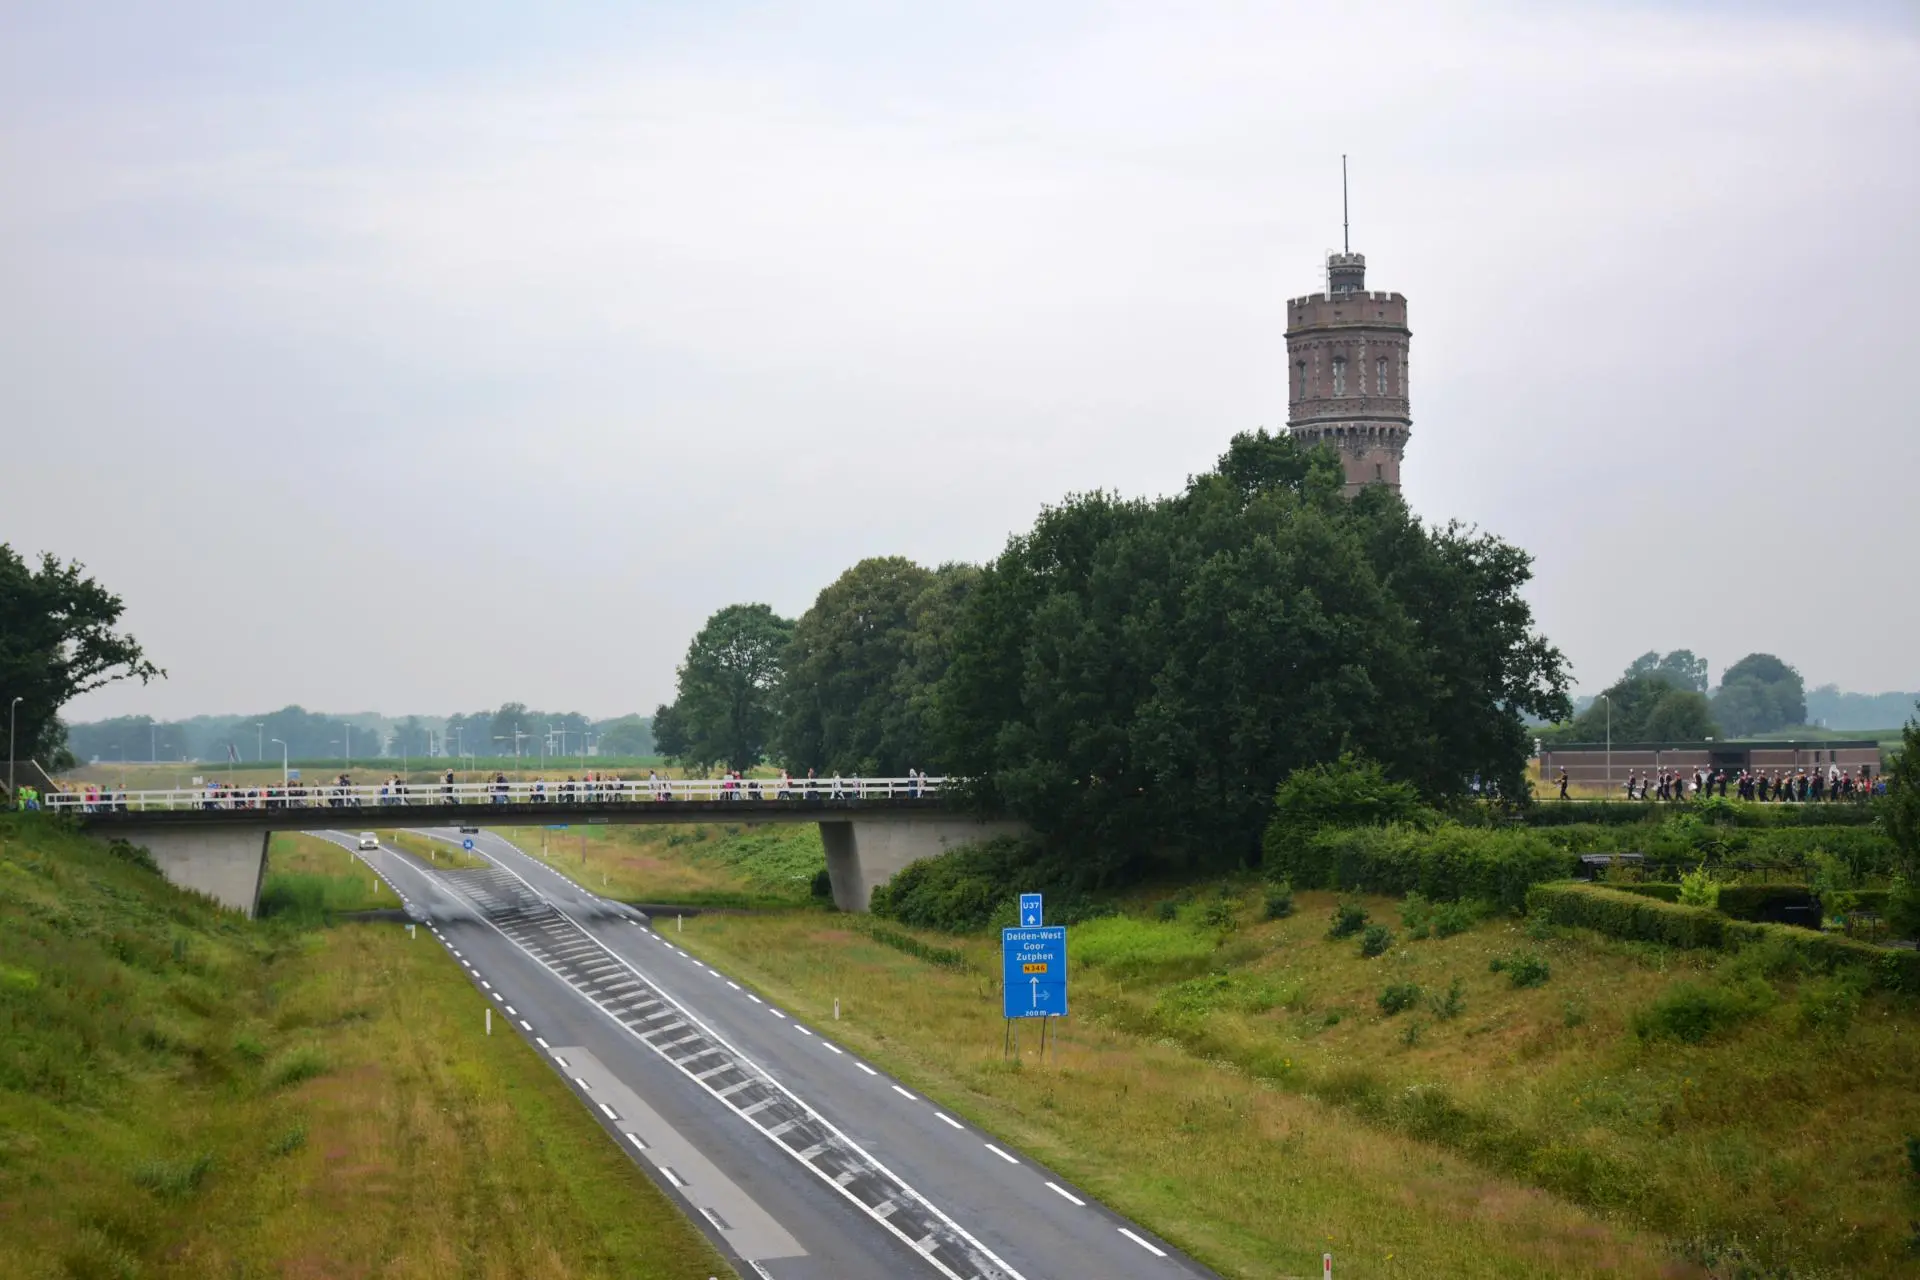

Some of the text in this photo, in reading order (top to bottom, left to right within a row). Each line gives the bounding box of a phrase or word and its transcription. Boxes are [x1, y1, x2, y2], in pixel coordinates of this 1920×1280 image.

[1006, 932, 1062, 941] Delden-West
[1023, 942, 1045, 950] Goor
[1016, 952, 1053, 962] Zutphen
